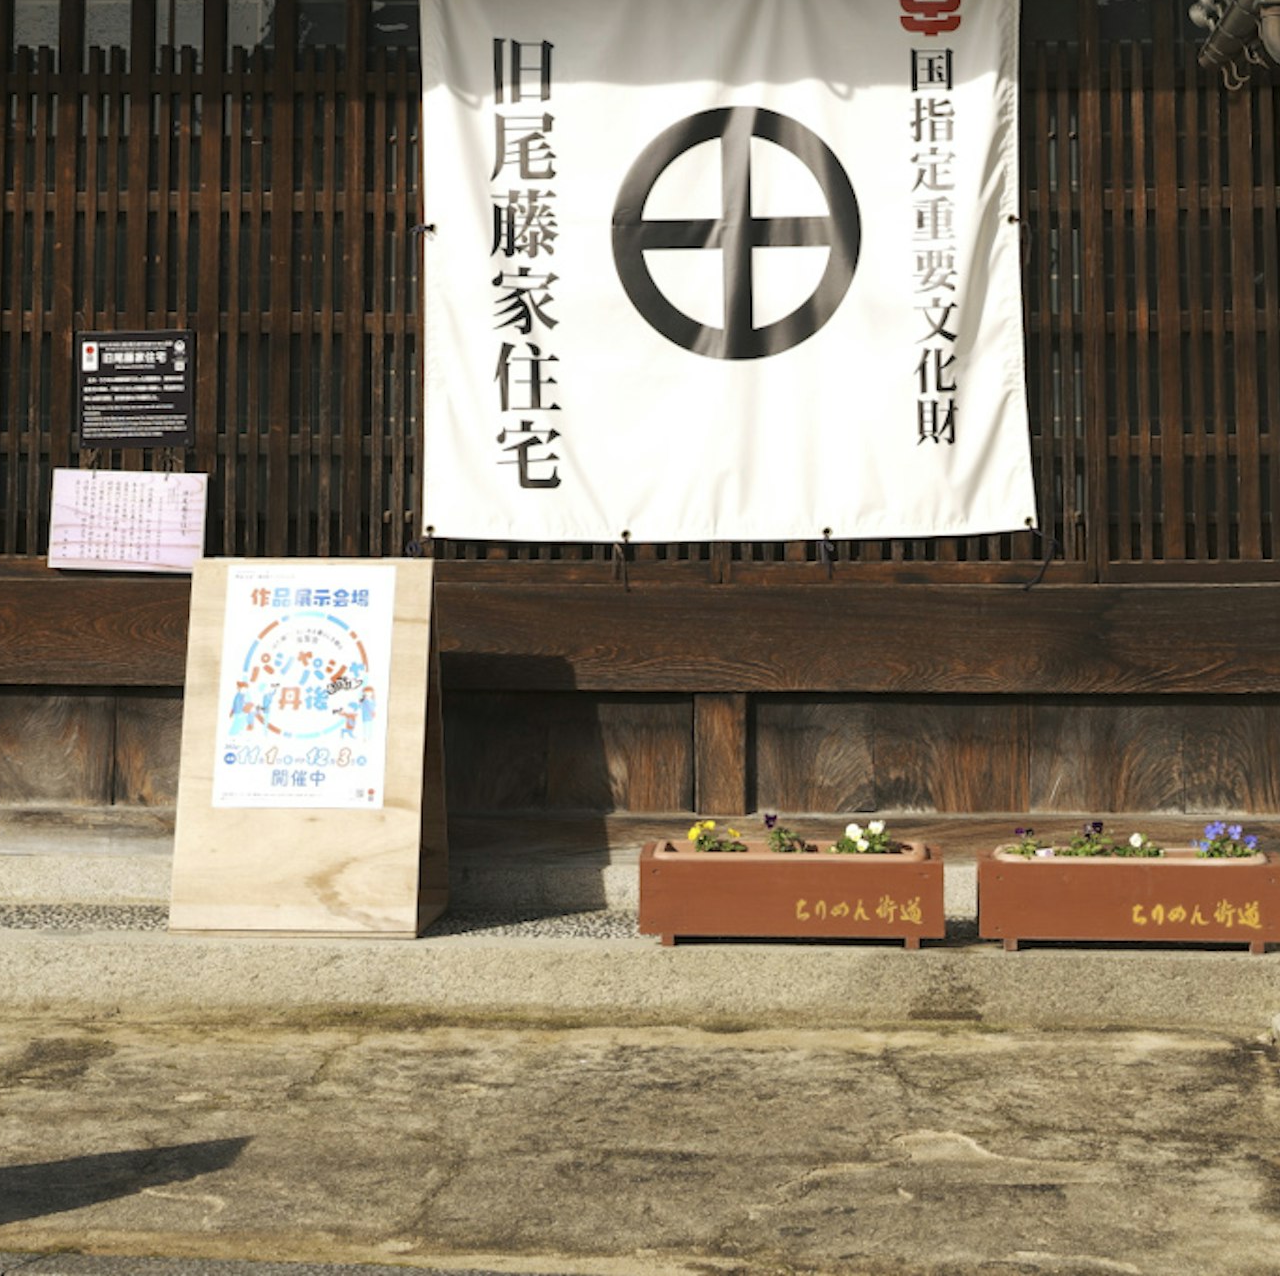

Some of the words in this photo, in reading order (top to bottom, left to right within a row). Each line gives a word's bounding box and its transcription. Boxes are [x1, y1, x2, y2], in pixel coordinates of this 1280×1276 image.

[908, 47, 958, 446] 国指定重要文化財
[490, 38, 561, 489] 旧尾藤家住宅
[251, 588, 369, 607] 作品展示会場
[278, 686, 329, 710] 丹後
[271, 769, 326, 787] 開催中
[796, 894, 923, 924] ちりめん街道
[1132, 898, 1263, 929] ちりめん街道
